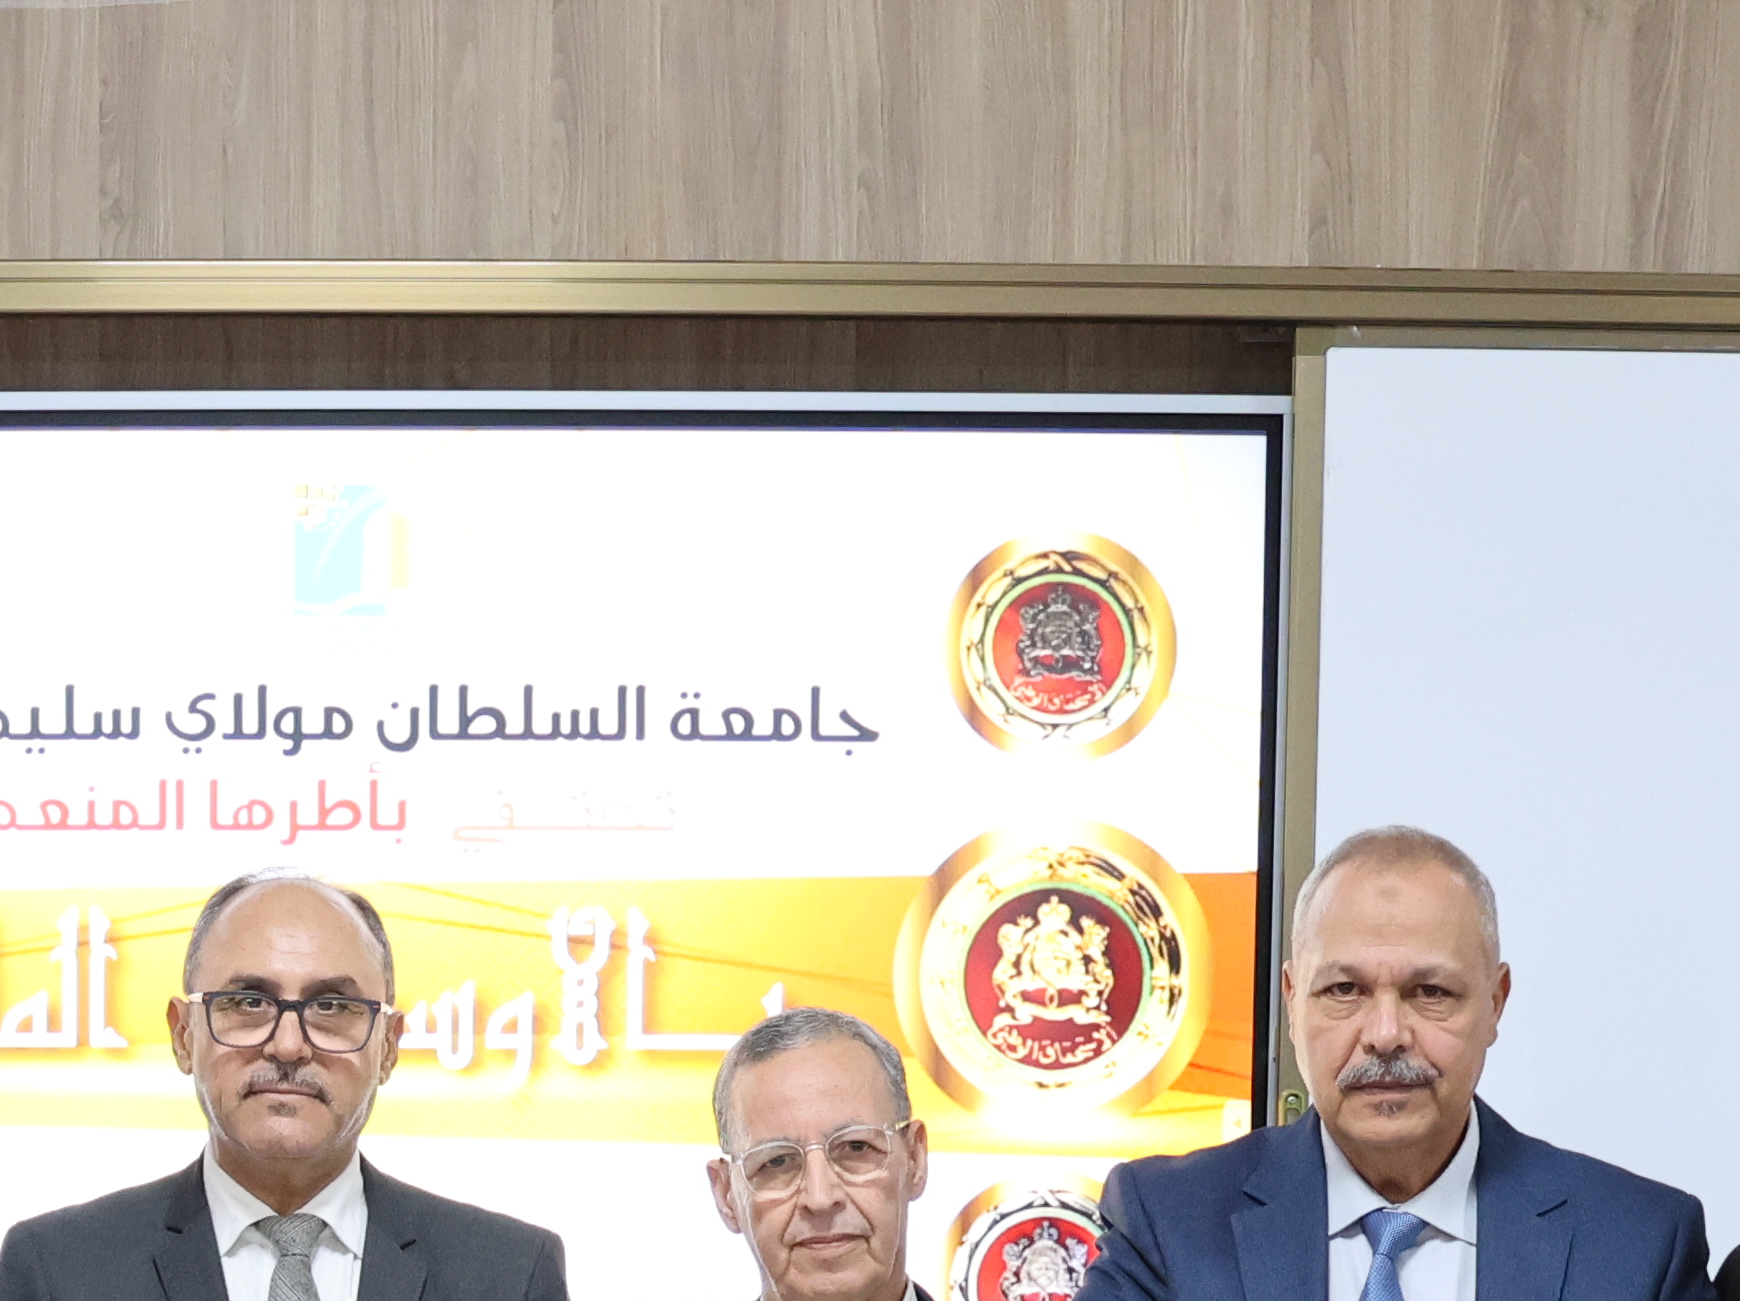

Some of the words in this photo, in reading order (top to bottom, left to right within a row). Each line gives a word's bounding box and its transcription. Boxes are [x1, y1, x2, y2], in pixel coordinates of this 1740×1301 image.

[165, 684, 354, 757] مولاي
[377, 684, 647, 753] السلطان
[670, 685, 880, 757] جامعة
[209, 761, 407, 846] بأطرها
